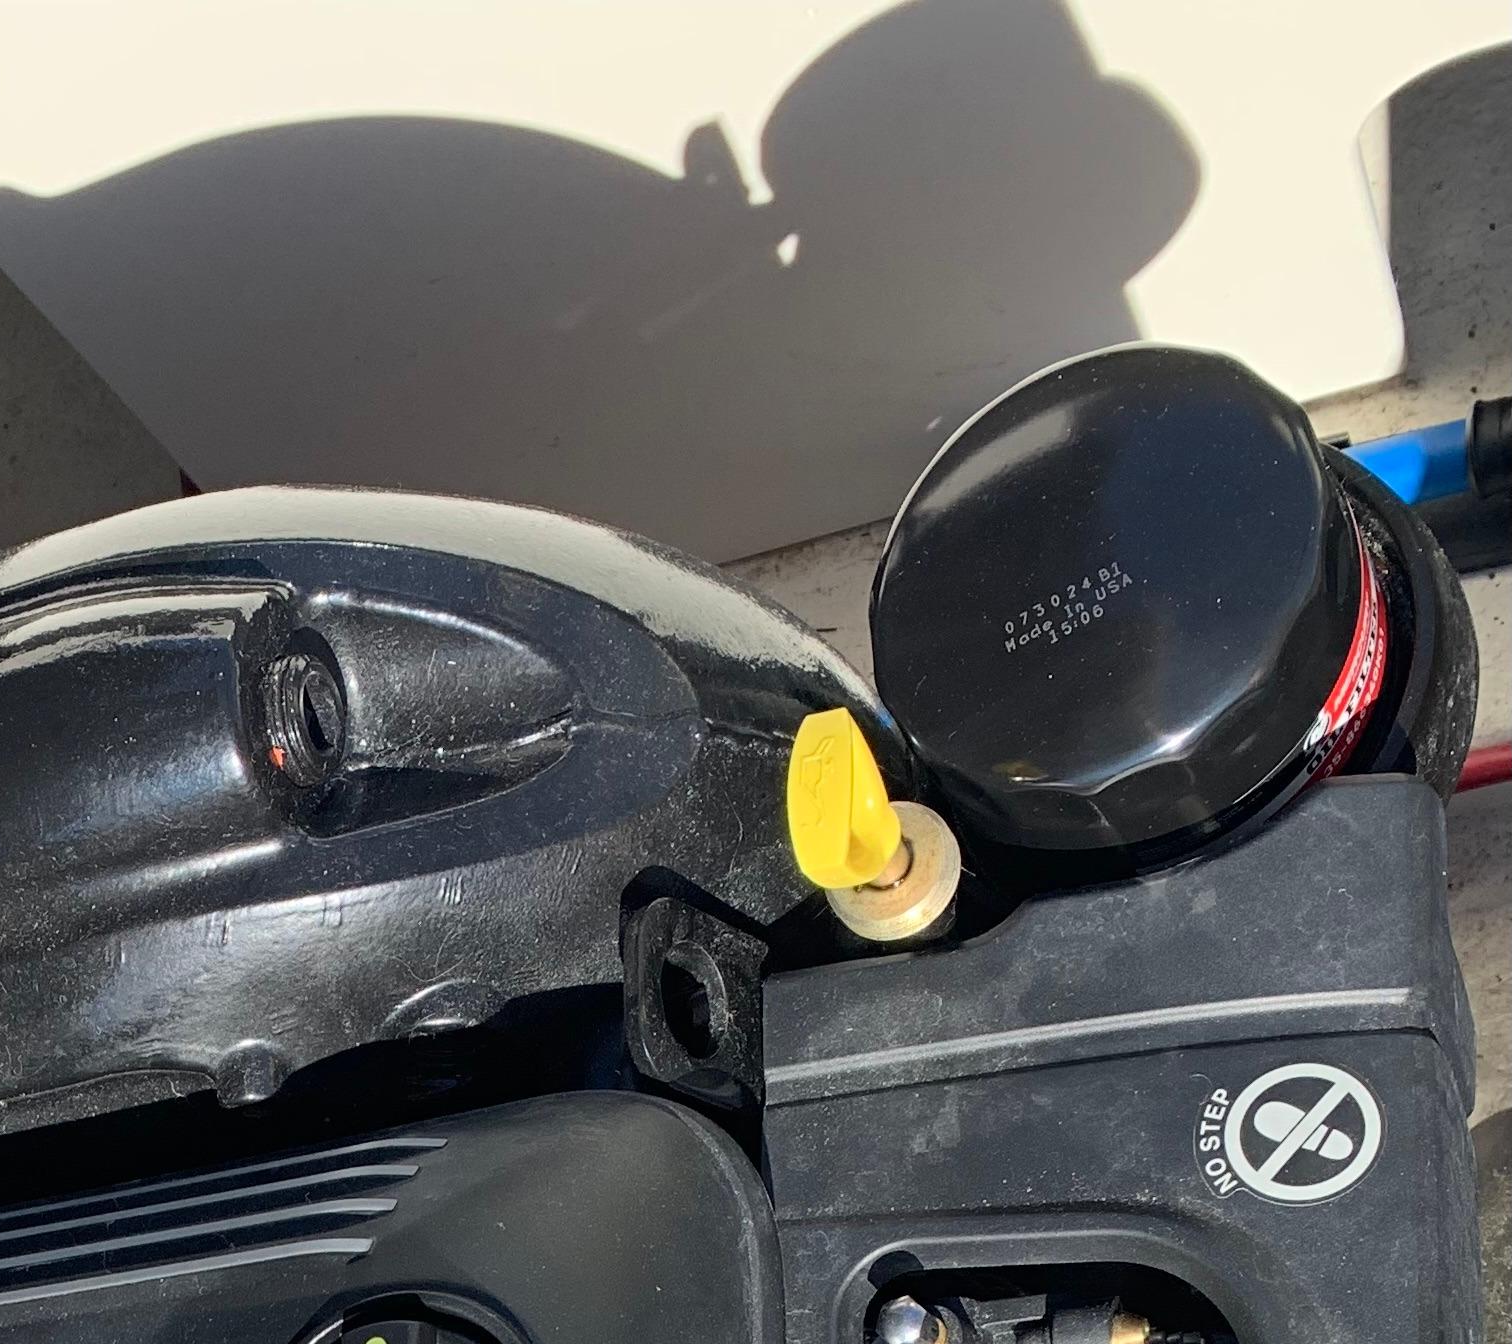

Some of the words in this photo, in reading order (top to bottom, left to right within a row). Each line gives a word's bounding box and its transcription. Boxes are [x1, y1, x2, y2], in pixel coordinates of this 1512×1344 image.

[1005, 618, 1053, 654] Made
[1066, 602, 1085, 623] In
[1095, 572, 1134, 607] USA
[1049, 603, 1104, 644] 15:06
[1199, 1088, 1228, 1152] STEP
[1205, 1159, 1238, 1195] NO
